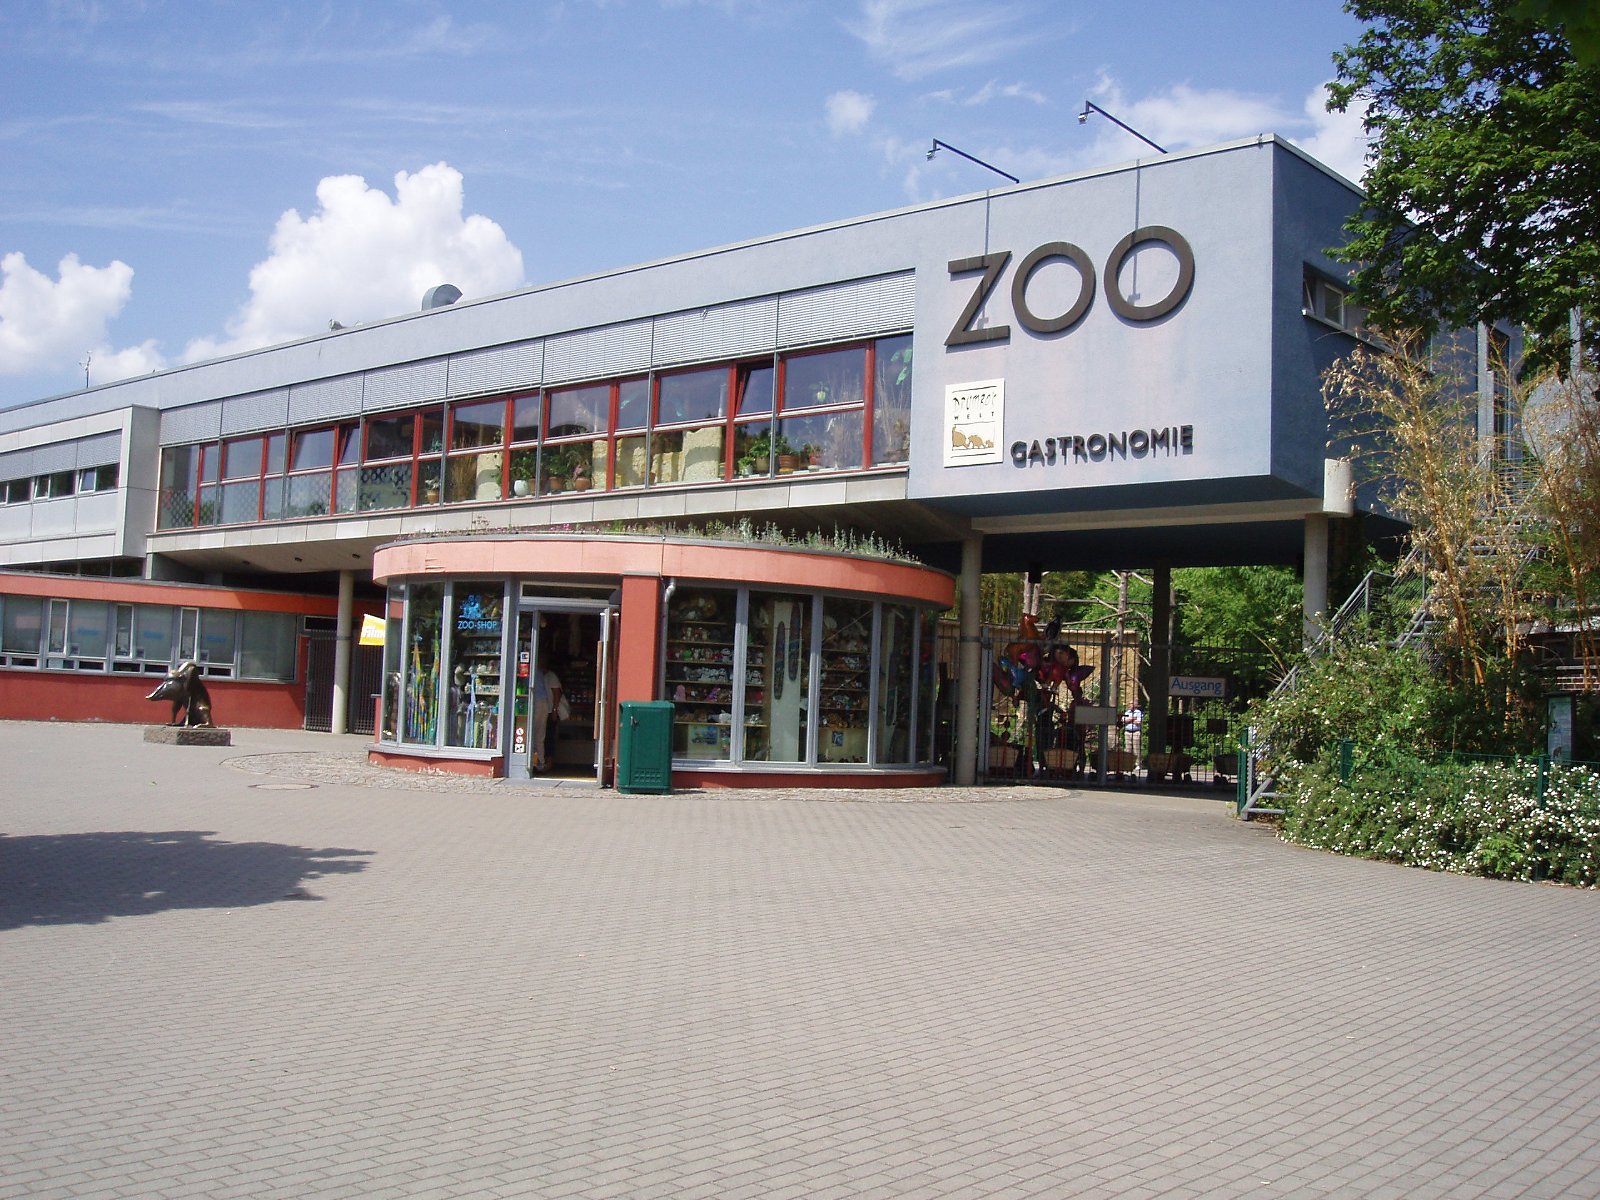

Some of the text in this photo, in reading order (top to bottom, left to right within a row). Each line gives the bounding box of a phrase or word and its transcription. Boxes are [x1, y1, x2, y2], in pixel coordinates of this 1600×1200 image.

[944, 225, 1195, 346] ZOO
[1011, 425, 1193, 462] GASTRONOMIE
[457, 620, 498, 630] ZOO-SHOP
[1171, 677, 1222, 695] Ausgang
